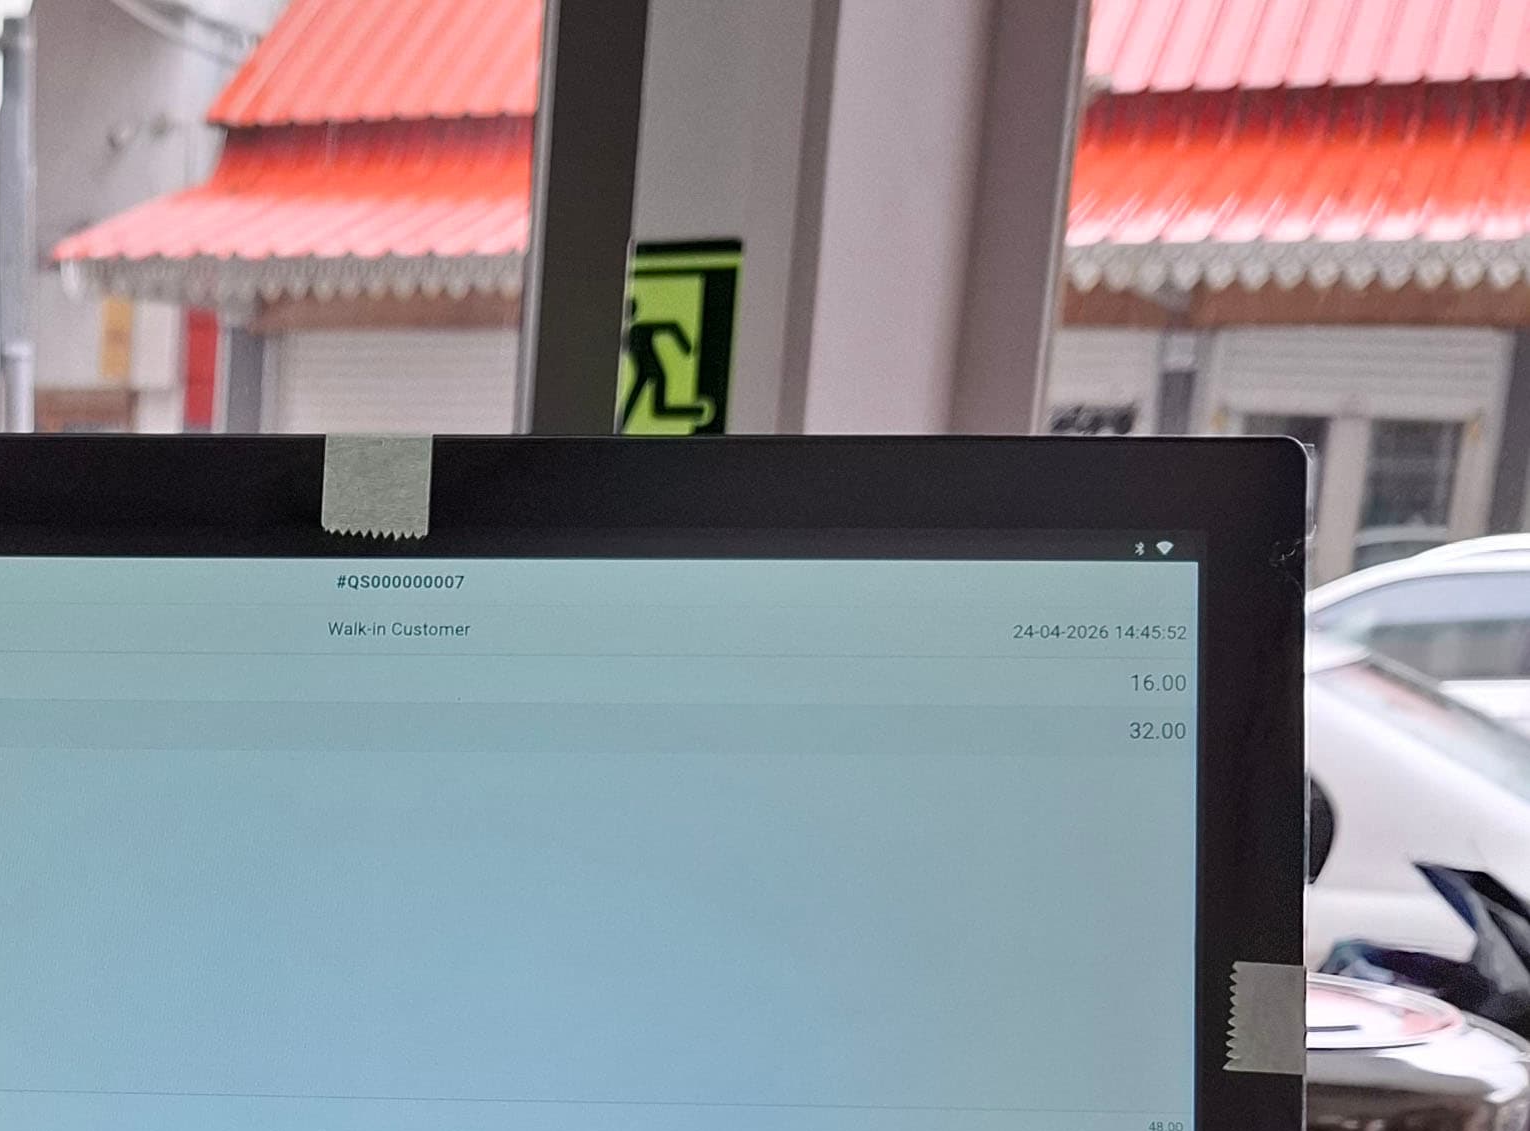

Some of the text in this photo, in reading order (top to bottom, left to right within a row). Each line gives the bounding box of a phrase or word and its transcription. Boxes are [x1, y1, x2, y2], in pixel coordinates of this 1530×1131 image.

[336, 574, 465, 590] #QS000000007
[327, 621, 470, 638] Walk-in Customer
[1012, 624, 1187, 641] 24-04-2026 14:45:52
[1130, 673, 1187, 693] 16.00
[1129, 721, 1187, 741] 32.00
